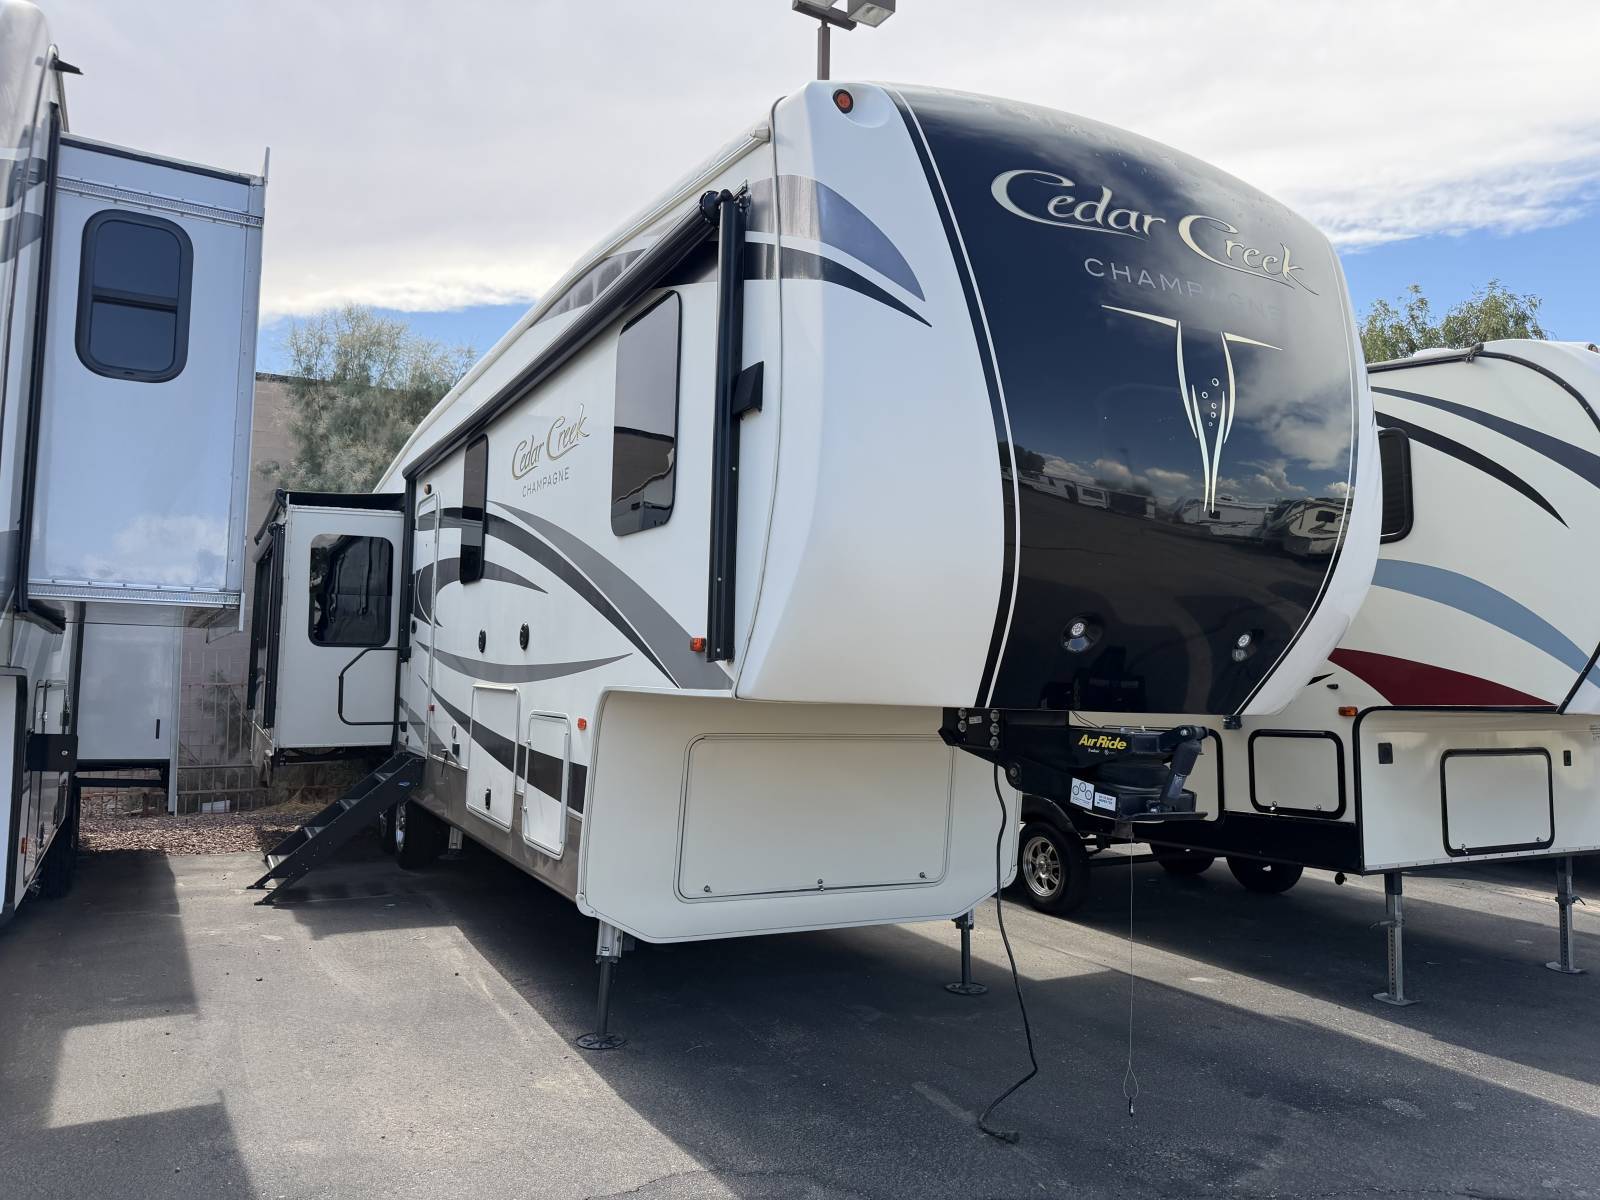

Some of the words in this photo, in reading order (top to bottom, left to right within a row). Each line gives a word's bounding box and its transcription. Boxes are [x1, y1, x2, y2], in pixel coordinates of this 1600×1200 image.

[991, 169, 1166, 241] Cedar
[1178, 214, 1319, 296] Creek
[512, 434, 545, 481] Cedar
[547, 402, 591, 461] Creek
[522, 466, 570, 498] CHAMPAGNE
